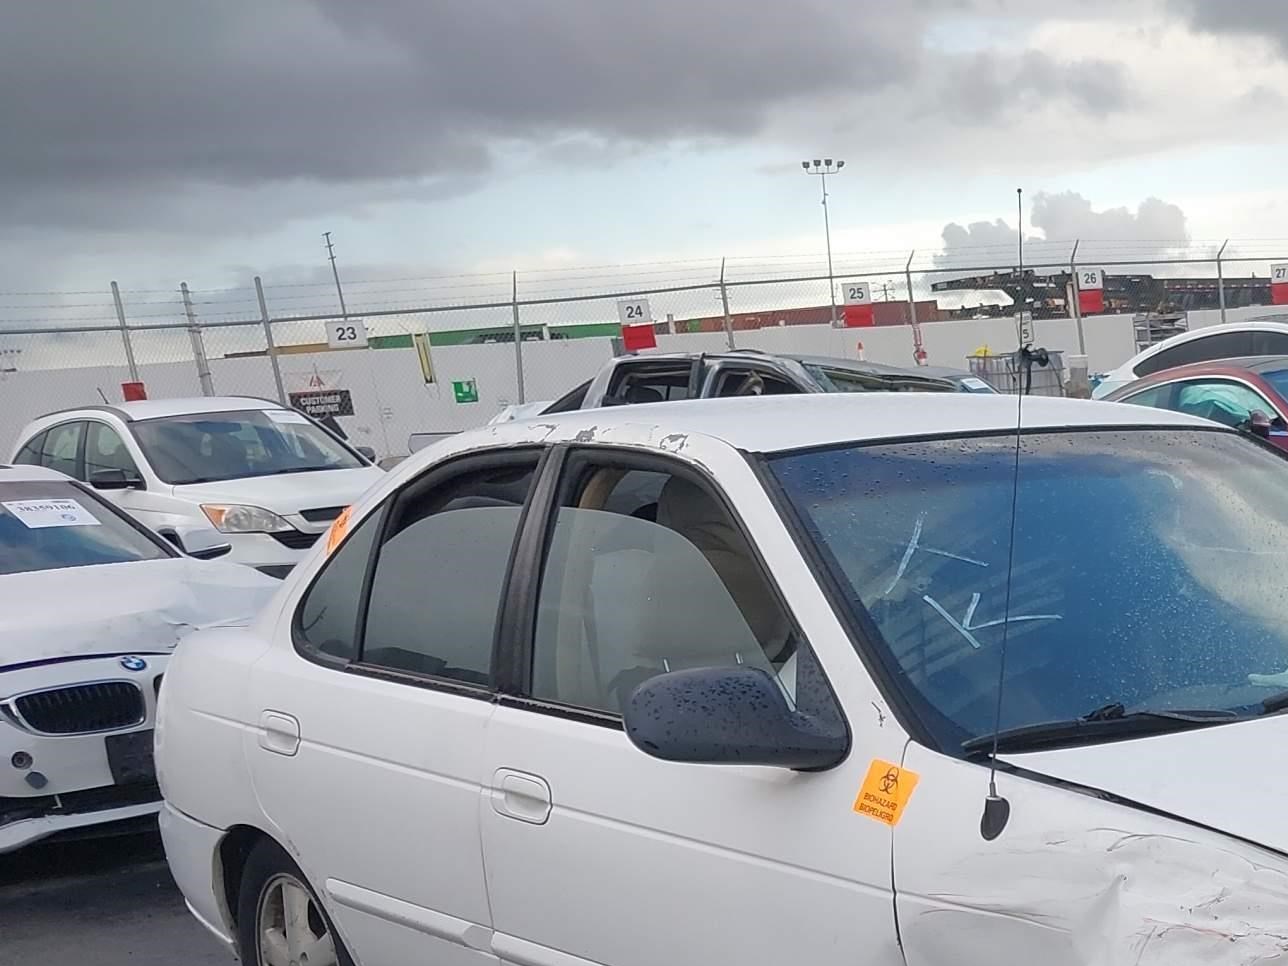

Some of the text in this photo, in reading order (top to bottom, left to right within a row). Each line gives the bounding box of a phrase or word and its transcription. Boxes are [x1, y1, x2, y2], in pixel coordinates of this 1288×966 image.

[1083, 272, 1097, 284] 26
[1275, 267, 1286, 279] 27
[849, 287, 864, 300] 25
[626, 305, 643, 318] 24
[336, 327, 357, 341] 23
